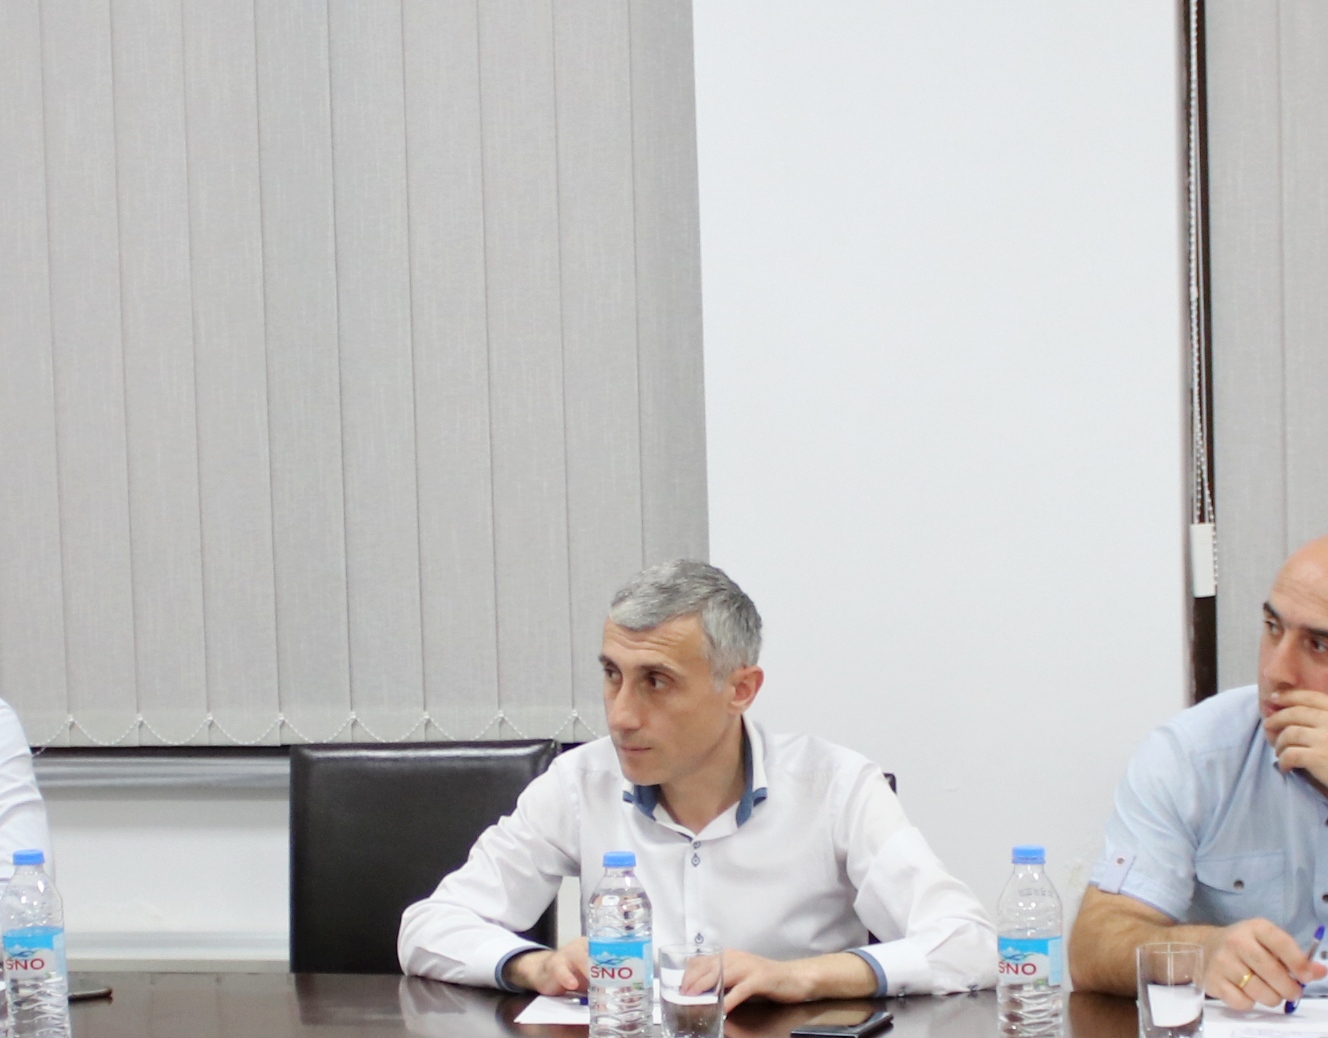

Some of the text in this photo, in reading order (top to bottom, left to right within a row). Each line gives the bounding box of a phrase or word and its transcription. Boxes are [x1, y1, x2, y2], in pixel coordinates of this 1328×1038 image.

[3, 957, 45, 971] SNO
[998, 960, 1037, 976] SNO
[590, 965, 633, 979] SNO
